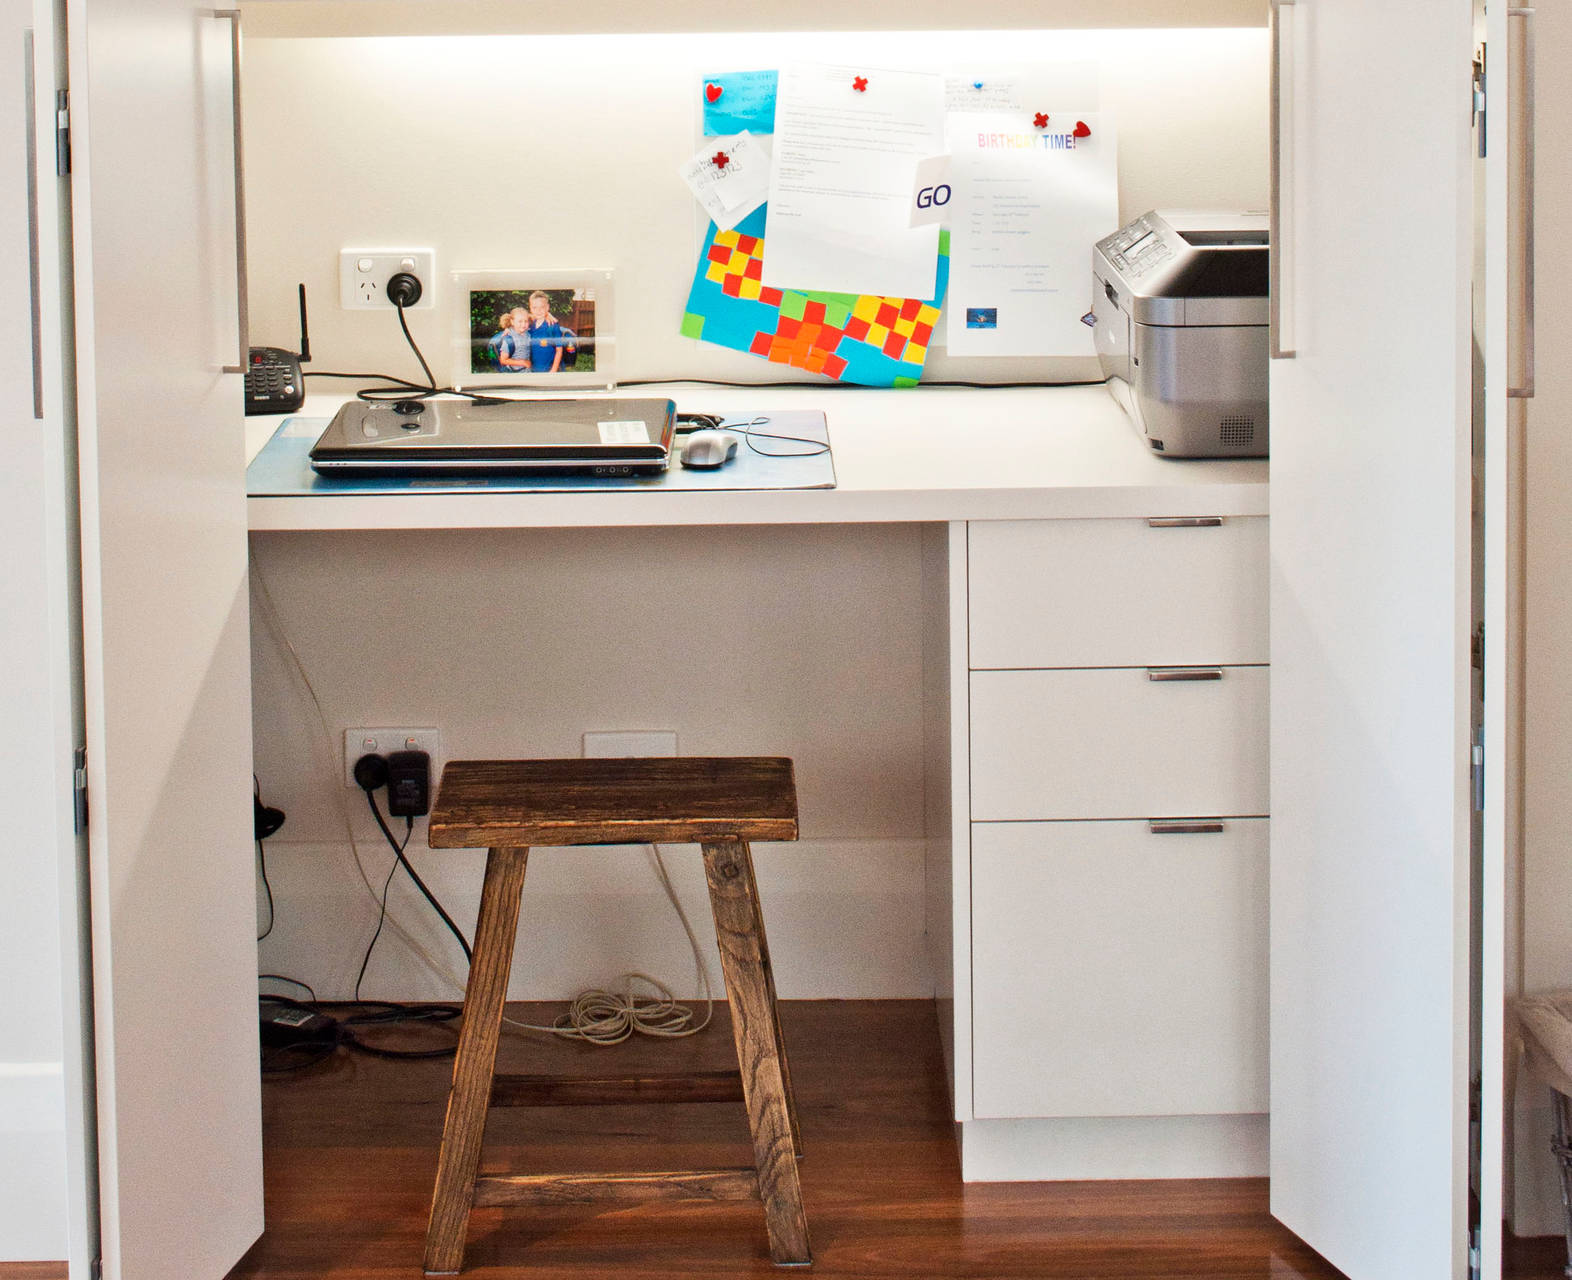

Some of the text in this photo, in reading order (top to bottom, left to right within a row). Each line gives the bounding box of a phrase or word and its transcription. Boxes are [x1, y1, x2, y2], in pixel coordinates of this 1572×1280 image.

[977, 133, 1076, 149] BIRTHDAY TIME!
[916, 184, 951, 209] GO
